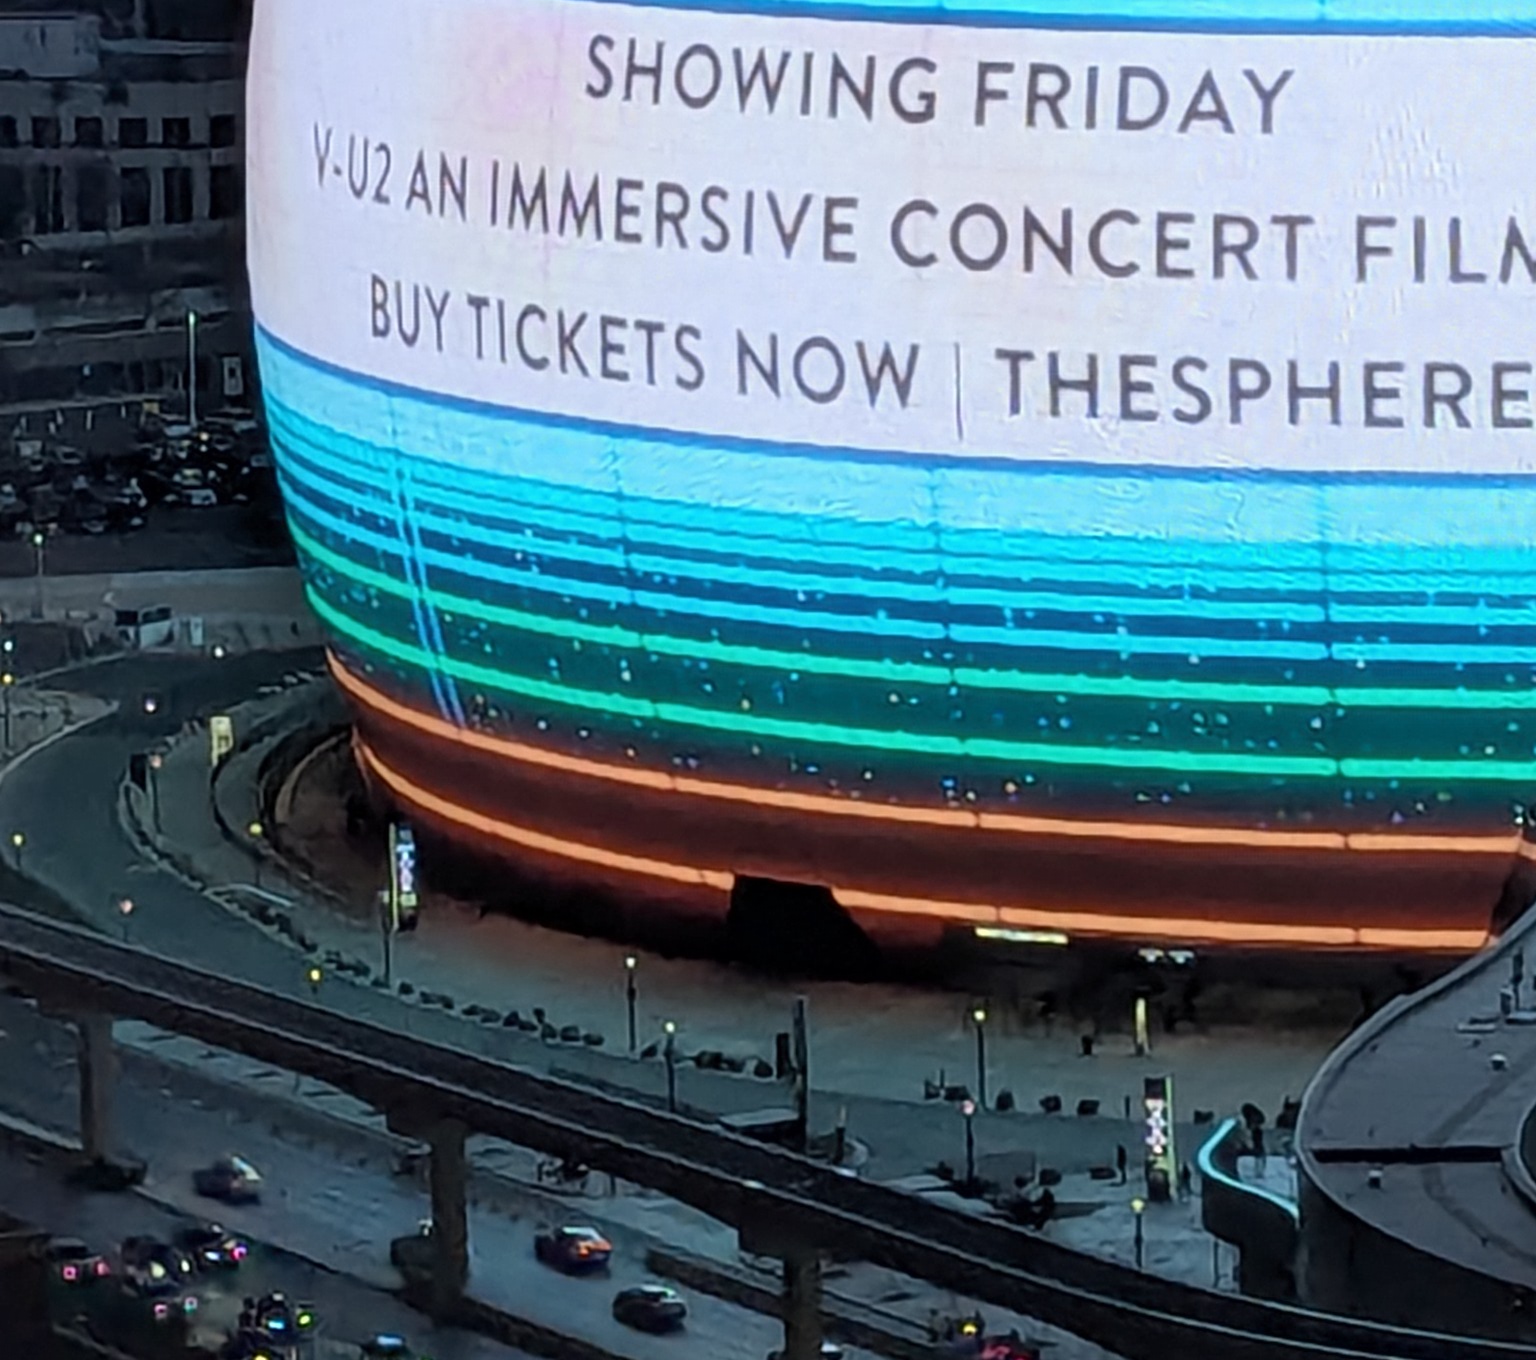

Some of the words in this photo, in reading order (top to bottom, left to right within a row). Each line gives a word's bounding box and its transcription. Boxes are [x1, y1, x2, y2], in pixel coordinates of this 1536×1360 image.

[584, 34, 938, 125] SHOWING
[974, 60, 1294, 135] FRIDAY
[313, 122, 392, 206] V-U2
[405, 149, 468, 222] AN
[490, 159, 859, 264] IMMERSIVE
[890, 199, 1315, 282] CONCERT
[370, 273, 451, 353] BUY
[466, 293, 705, 392] TICKETS
[736, 328, 920, 409] NOW
